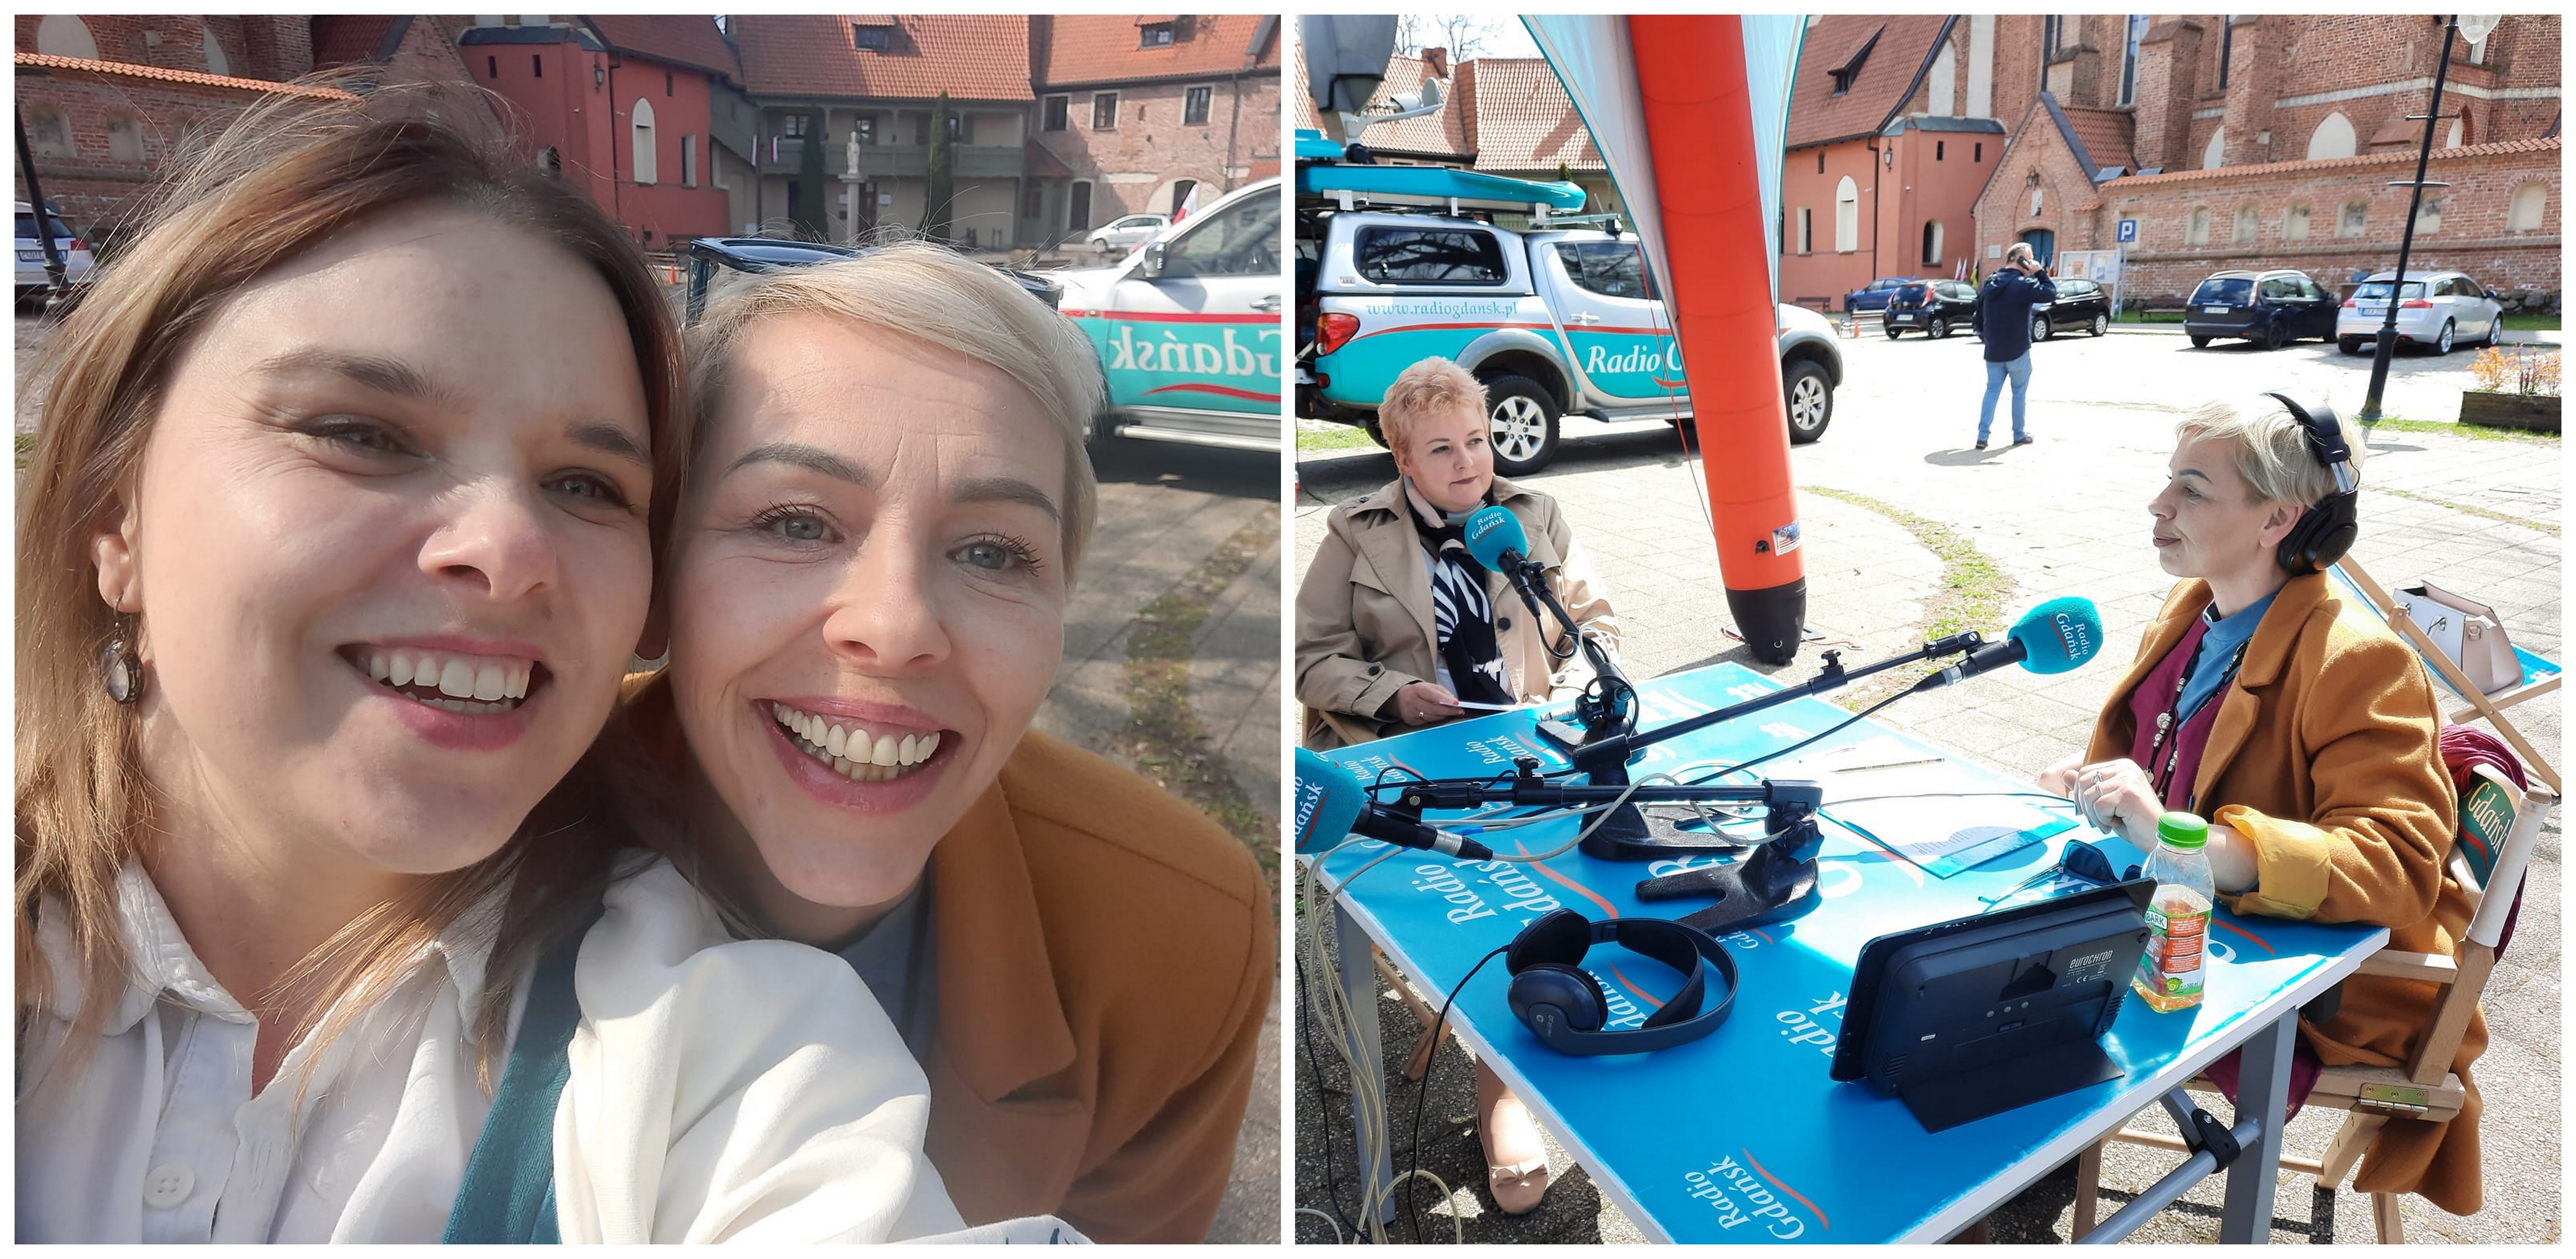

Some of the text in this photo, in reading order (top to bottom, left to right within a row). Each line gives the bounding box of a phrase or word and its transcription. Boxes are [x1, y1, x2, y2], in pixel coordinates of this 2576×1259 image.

[2121, 222, 2133, 240] P
[1366, 302, 1517, 319] www.radiogdansk.pl
[1585, 345, 1660, 373] Radio
[1472, 517, 1505, 540] Gdańsk
[1477, 512, 1502, 526] Radio
[2056, 613, 2081, 660] Gdańsk
[2075, 623, 2090, 655] Radio
[1465, 741, 1507, 765] Radio
[1485, 735, 1545, 768] ańsk
[1343, 761, 1375, 780] Radio
[1295, 782, 1324, 840] ańsk
[2468, 782, 2511, 855] Gdańsk
[1411, 864, 1499, 925] Radio
[1452, 859, 1561, 927] dańs
[2144, 912, 2164, 928] BARK
[1776, 1011, 1836, 1058] dio
[1684, 1171, 1751, 1231] Radio
[1707, 1155, 1805, 1240] Gdańsk
